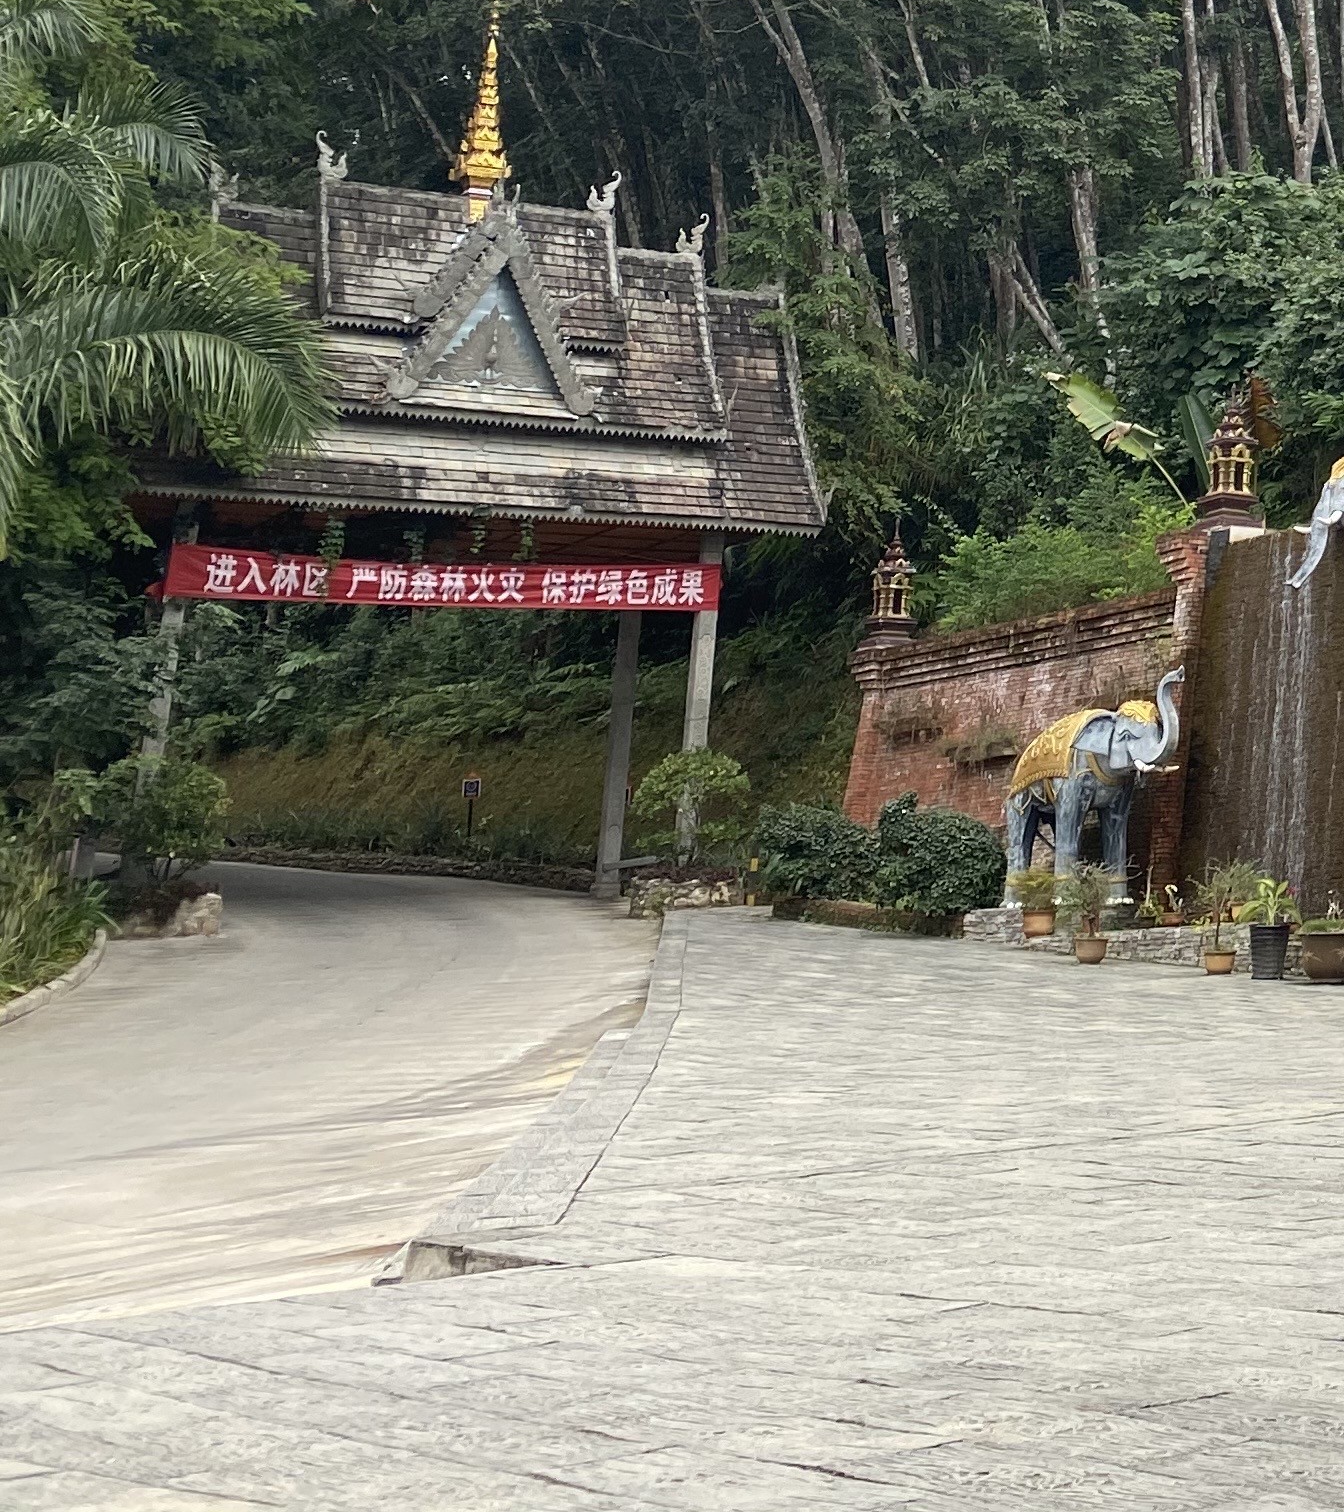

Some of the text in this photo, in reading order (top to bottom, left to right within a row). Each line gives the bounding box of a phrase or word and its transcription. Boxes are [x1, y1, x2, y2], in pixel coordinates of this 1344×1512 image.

[203, 553, 704, 605] 进入林区 严防森林火灾 保护绿色成果
